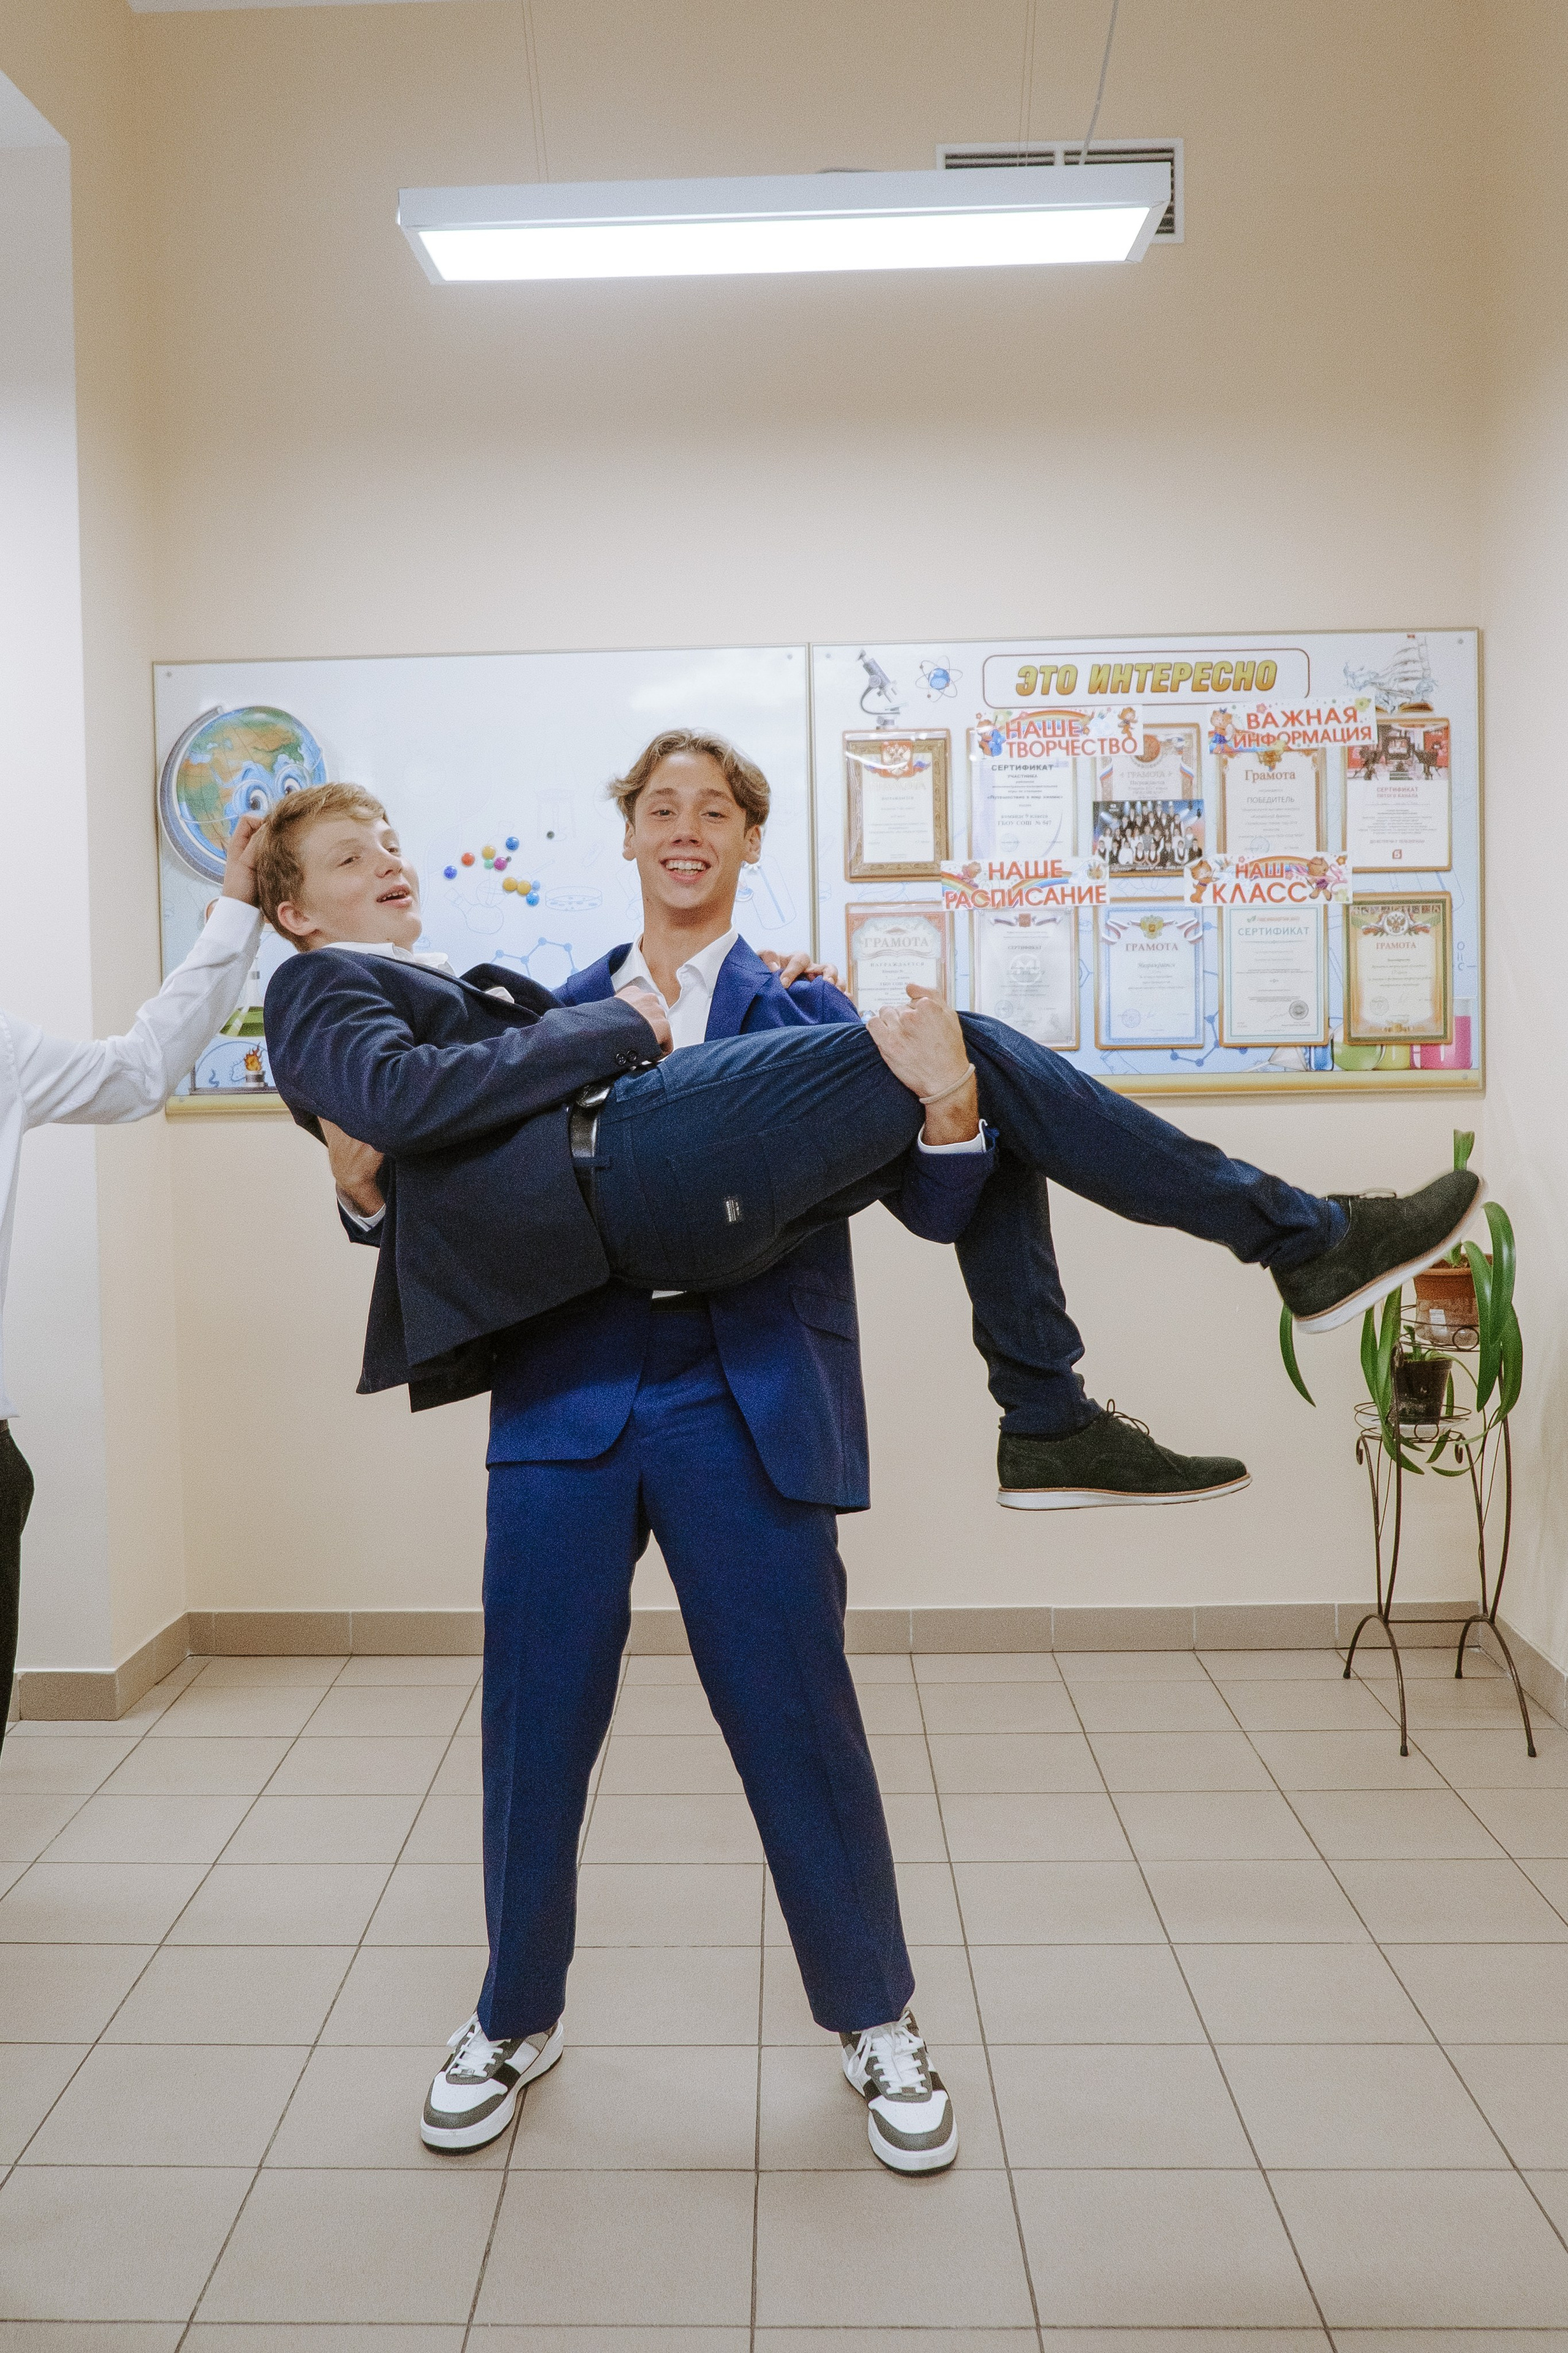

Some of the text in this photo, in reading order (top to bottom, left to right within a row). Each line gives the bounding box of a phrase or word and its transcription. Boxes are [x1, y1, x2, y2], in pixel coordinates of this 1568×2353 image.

[1016, 659, 1278, 696] ЭТО ИНТЕРЕСНО
[1005, 717, 1081, 739] НАШЕ
[1246, 704, 1359, 730] ВАЖНАЯ
[1006, 736, 1139, 758] ТВОРЧЕСТВО
[1233, 726, 1373, 751] ИНФОРМАЦИЯ
[1245, 769, 1296, 783] Грамота
[987, 859, 1063, 880] НАШЕ
[1235, 862, 1287, 879] НАШ
[943, 884, 1107, 909] РАСПИСАНИЕ
[1212, 882, 1308, 904] КЛАСС
[1237, 926, 1310, 936] СЕРТИФИКАТ
[863, 937, 929, 948] ГРАМОТА
[1126, 943, 1178, 951] ГРАМОТА
